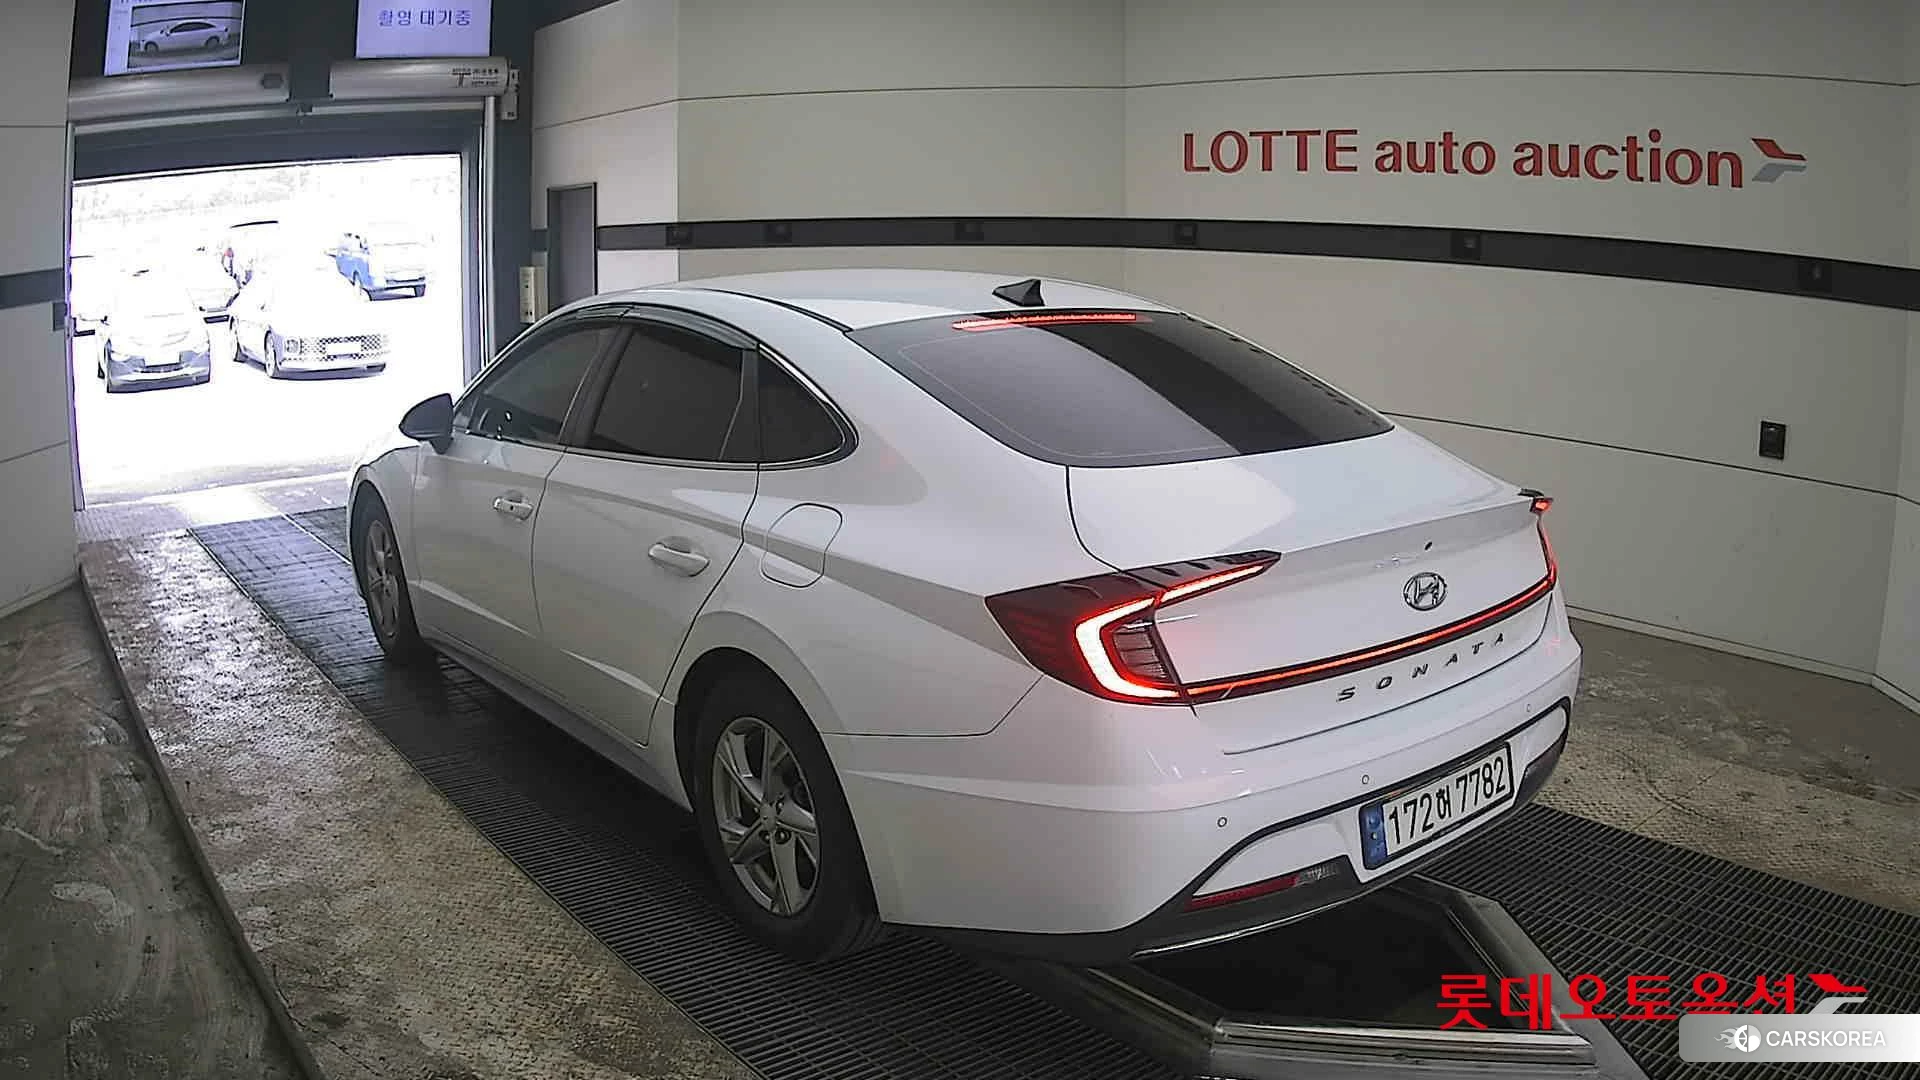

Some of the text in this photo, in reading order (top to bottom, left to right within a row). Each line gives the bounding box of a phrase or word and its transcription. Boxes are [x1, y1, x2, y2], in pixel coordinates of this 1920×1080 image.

[378, 9, 472, 27] 촬영 대기중
[1183, 128, 1744, 188] LOTTE auto auction
[1336, 632, 1505, 703] SONATA
